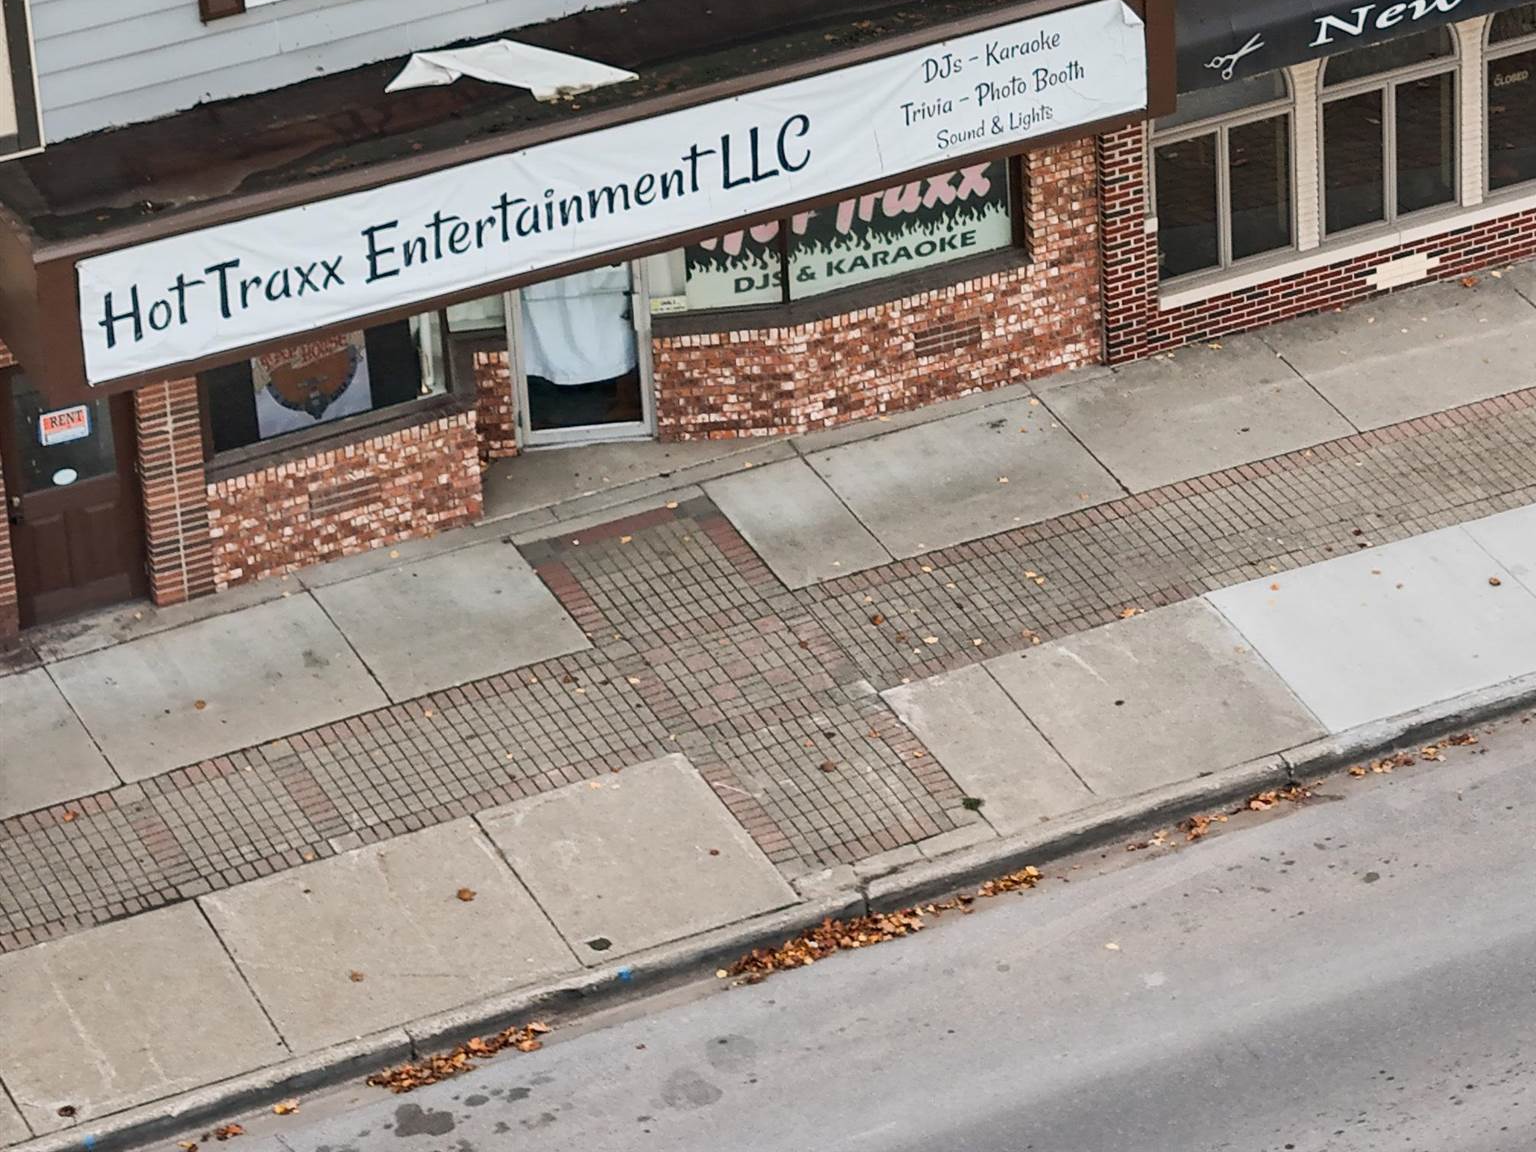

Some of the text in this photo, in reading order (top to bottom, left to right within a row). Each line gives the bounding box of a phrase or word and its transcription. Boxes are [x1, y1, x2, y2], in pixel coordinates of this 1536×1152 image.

[921, 53, 963, 84] DJs
[985, 30, 1061, 67] Karaoke
[1493, 69, 1530, 87] CLOSED
[900, 97, 953, 127] Trivia
[974, 76, 1027, 107] Photo
[1031, 60, 1085, 93] Booth
[936, 104, 1054, 149] Sound & Lights
[98, 274, 205, 349] Hot
[205, 255, 345, 320] Traxx
[361, 144, 717, 284] Entertainment
[720, 114, 811, 190] LLC
[796, 265, 816, 283] &
[826, 229, 977, 277] KARAOKE
[49, 410, 83, 429] RENT
